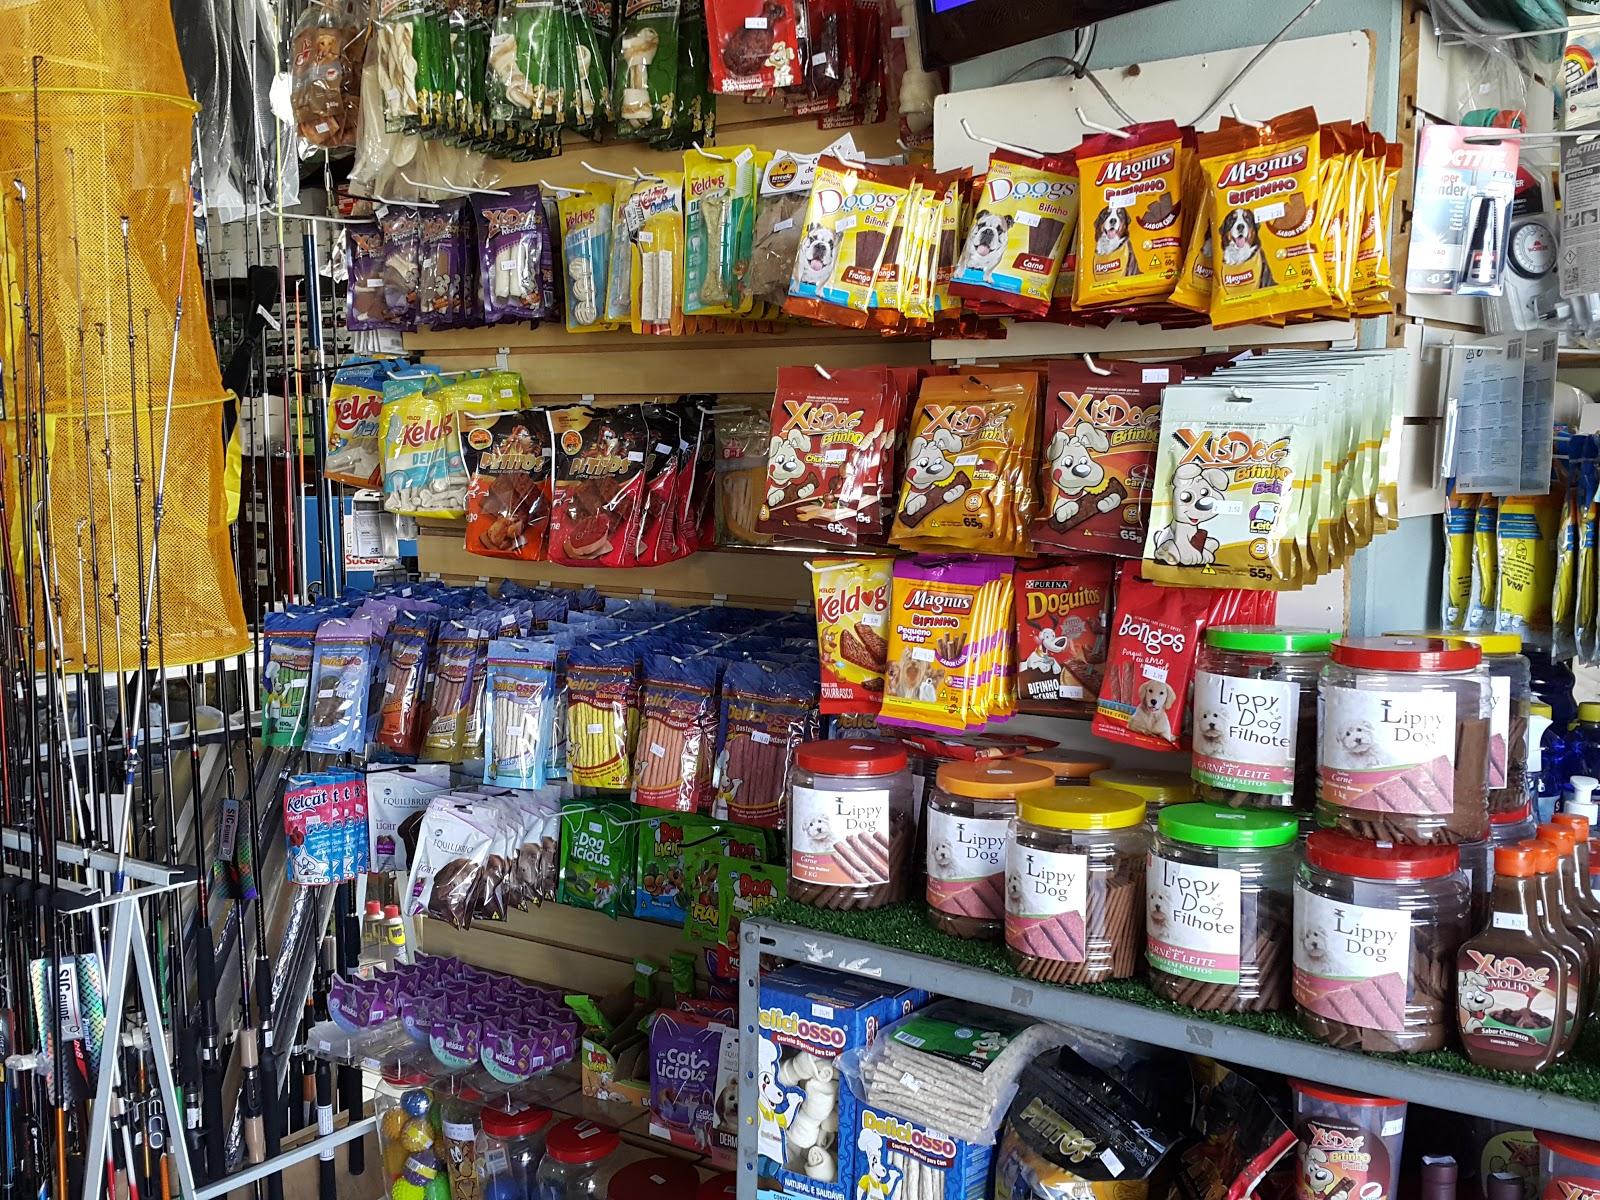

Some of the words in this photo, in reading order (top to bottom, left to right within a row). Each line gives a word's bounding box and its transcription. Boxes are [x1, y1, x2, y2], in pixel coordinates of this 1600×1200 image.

[1096, 152, 1171, 186] Magnus
[1218, 151, 1304, 188] Magnus
[988, 178, 1076, 204] Doogs
[1228, 178, 1296, 204] BIFINHO
[818, 189, 898, 215] Doogs
[1038, 203, 1069, 217] Bifinho
[1022, 259, 1044, 271] Carne
[1195, 262, 1213, 276] Magn
[848, 270, 871, 283] Frango
[1224, 271, 1252, 284] Magnus
[822, 430, 864, 446] Bifinho
[972, 470, 998, 482] Frango
[1234, 464, 1292, 483] Bifinho
[1124, 478, 1154, 488] Carne
[827, 524, 848, 535] 65g
[963, 516, 983, 530] 65g
[1120, 530, 1143, 544] 65g
[1250, 567, 1272, 580] 55g
[1034, 580, 1068, 589] PURINA
[904, 589, 970, 614] Magnus
[1026, 589, 1100, 620] Doguitos
[912, 615, 958, 628] BIFINHO
[897, 626, 932, 638] Pequeno
[902, 633, 926, 644] Porte
[1119, 614, 1186, 654] Bongos
[1144, 654, 1164, 666] amo
[821, 686, 854, 700] CHURRASCO
[1028, 679, 1059, 694] BIFINHO
[1220, 679, 1279, 710] Lippy
[1239, 708, 1281, 734] Dog
[1229, 726, 1290, 748] Filhote
[1236, 768, 1271, 780] LEITE
[1331, 772, 1353, 784] Carne
[287, 788, 327, 814] Kelcat
[383, 796, 430, 806] EQUILÍBRIO
[836, 796, 882, 818] Lippy
[376, 822, 396, 832] LIGHT
[846, 818, 876, 832] Dog
[579, 832, 605, 853] Dog
[958, 828, 1006, 850] Lippy
[800, 856, 818, 864] Carne
[966, 847, 998, 864] Dog
[1026, 860, 1076, 886] Lippy
[1164, 861, 1220, 899] Lippy
[1035, 882, 1068, 902] Dog
[1182, 892, 1224, 920] Dog
[1174, 910, 1235, 934] Filhote
[1334, 909, 1398, 946] Lippy
[1344, 939, 1388, 962] Dog
[1174, 952, 1180, 961] E
[1182, 954, 1216, 968] LEITE
[1491, 980, 1530, 993] MOLHO
[1482, 1027, 1498, 1036] Sabor
[1499, 1029, 1529, 1042] Churrasco
[667, 1049, 710, 1068] Cat
[815, 1046, 824, 1055] para
[656, 1059, 708, 1082] Licious
[1329, 1151, 1370, 1164] Bifinho
[784, 1178, 810, 1192] NATURAL
[811, 1186, 815, 1194] E
[816, 1186, 845, 1200] SAUDÁVEL
